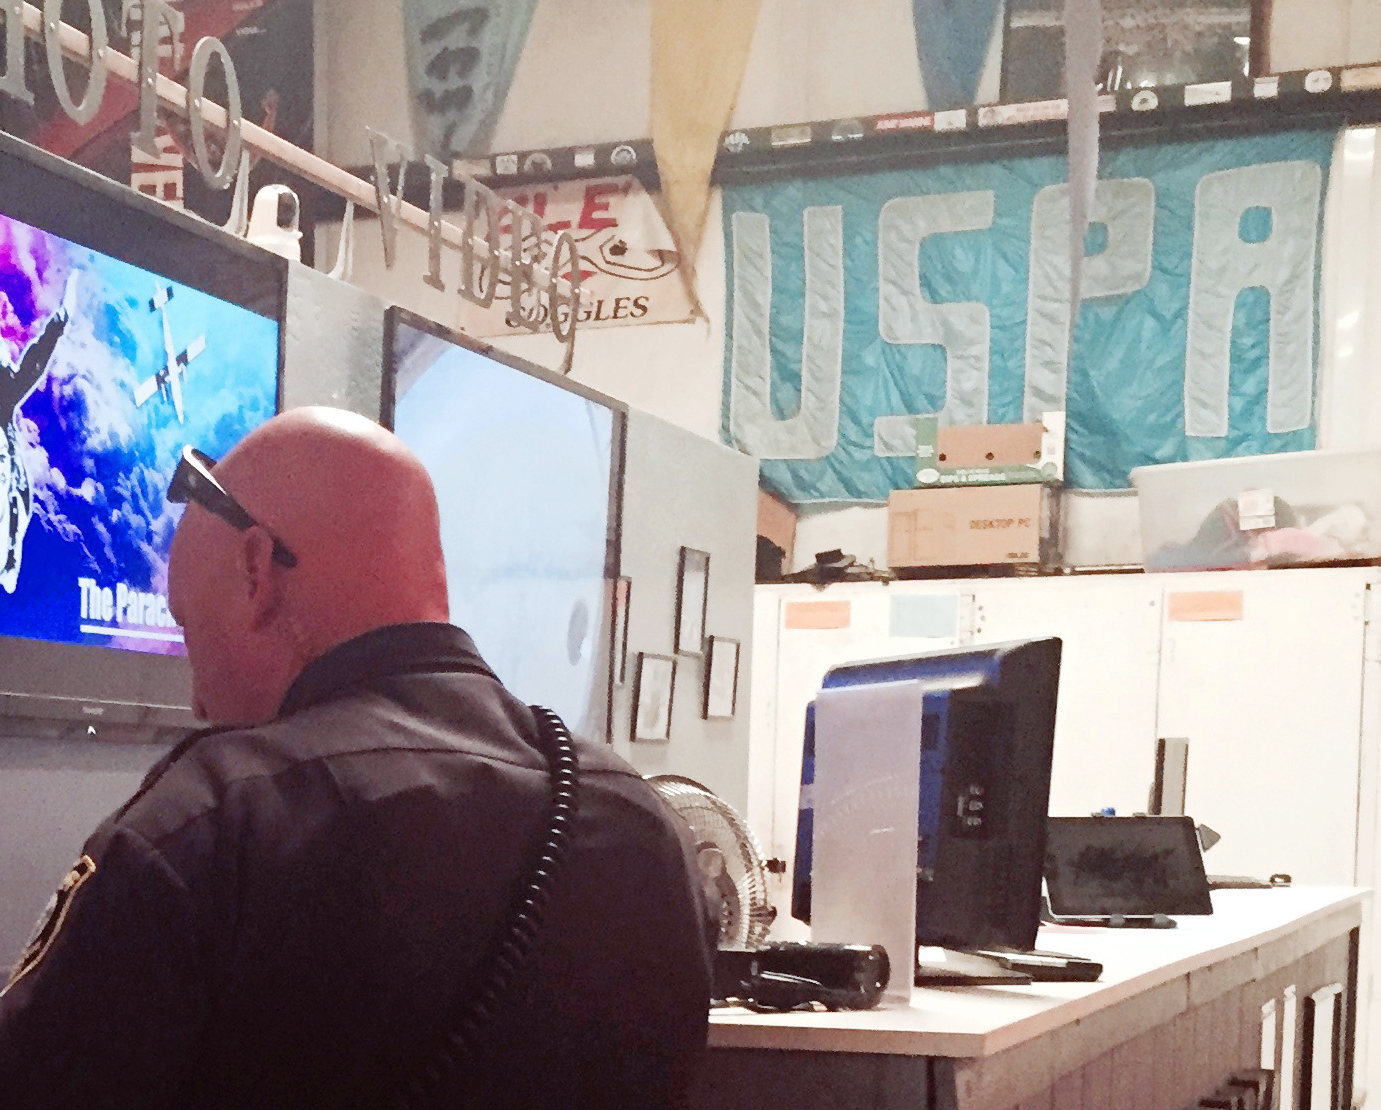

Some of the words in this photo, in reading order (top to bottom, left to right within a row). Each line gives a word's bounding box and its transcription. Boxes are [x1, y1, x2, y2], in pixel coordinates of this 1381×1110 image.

[366, 126, 580, 343] VIDEO
[729, 158, 1322, 460] USPA
[77, 577, 114, 622] The
